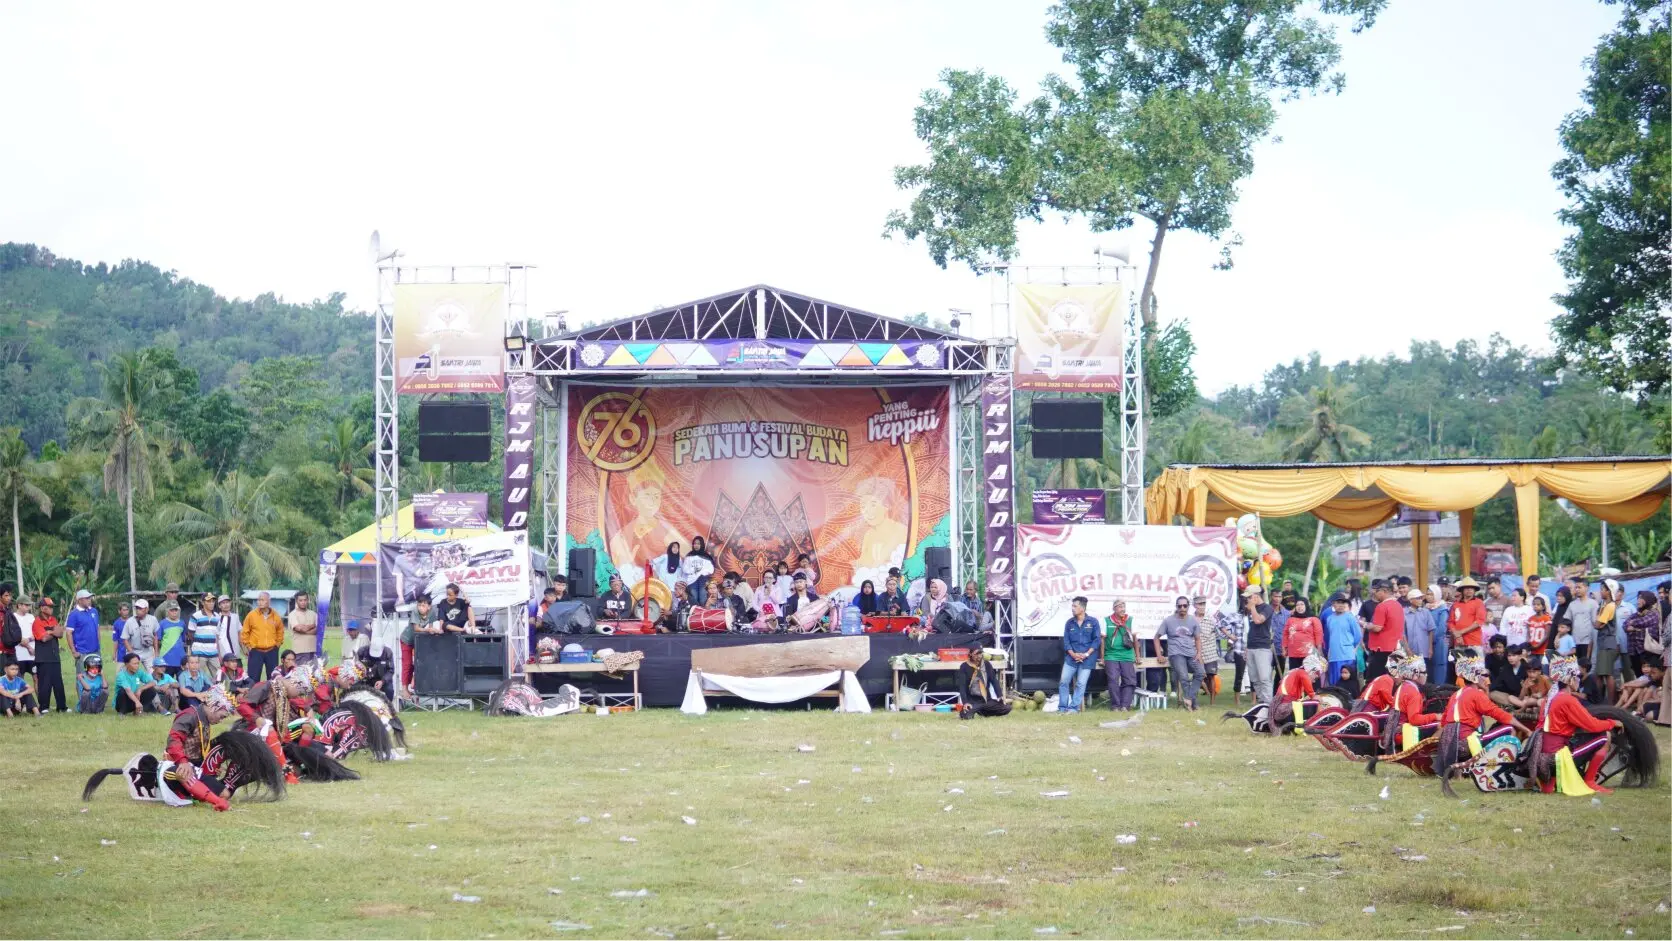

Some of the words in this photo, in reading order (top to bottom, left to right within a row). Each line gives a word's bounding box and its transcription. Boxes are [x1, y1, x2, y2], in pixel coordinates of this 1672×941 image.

[873, 408, 917, 423] PENTING
[882, 401, 909, 412] YANG
[587, 399, 641, 461] 76
[675, 424, 719, 440] SEDEKAH
[721, 422, 747, 434] BUMI
[749, 421, 757, 433] &
[760, 422, 804, 435] FESTIVAL
[806, 425, 848, 442] BUDAYA
[674, 432, 848, 466] PANUSUPAN
[508, 463, 529, 527] AUD
[988, 464, 1009, 574] AUDIO
[444, 564, 521, 582] WAHYU
[1039, 573, 1103, 598] MUGI
[1112, 573, 1215, 599] RAHAYU
